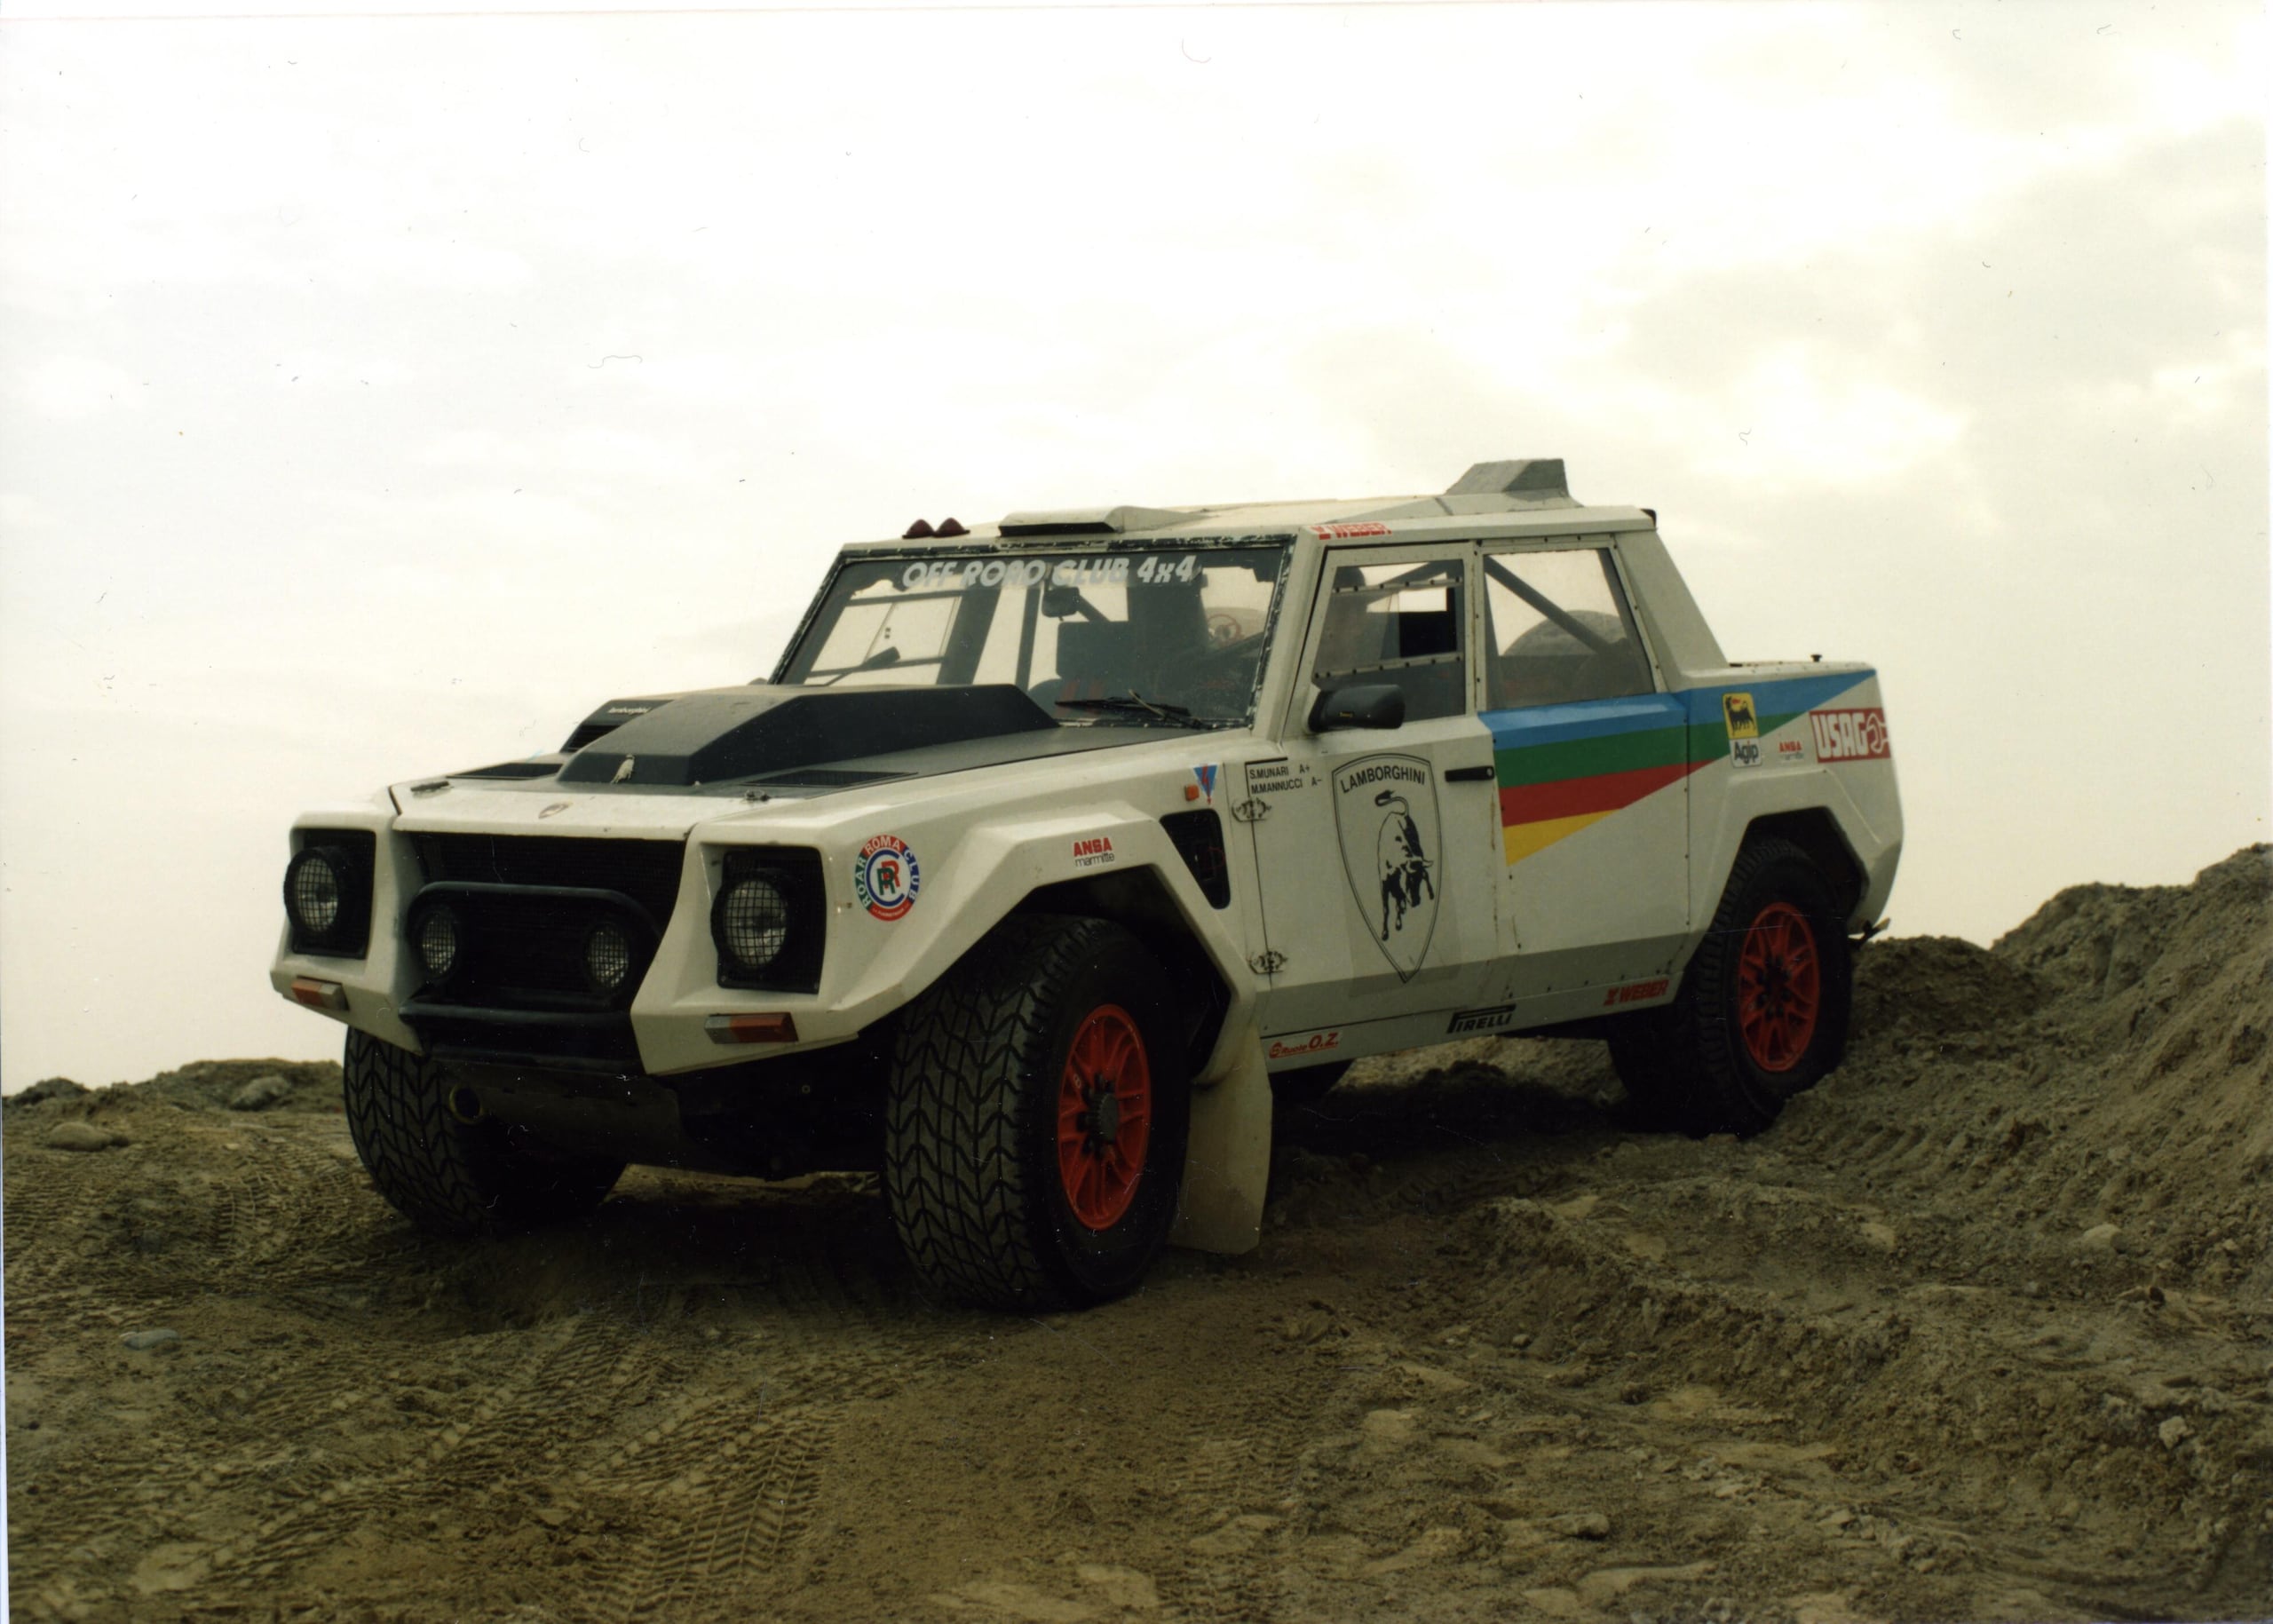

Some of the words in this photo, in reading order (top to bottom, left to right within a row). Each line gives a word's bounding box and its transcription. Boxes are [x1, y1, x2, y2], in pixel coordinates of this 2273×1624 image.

[902, 561, 957, 588] OFF
[960, 559, 1046, 587] ROAD
[1052, 558, 1129, 586] CLUB
[1136, 555, 1197, 583] 4x4
[1811, 712, 1868, 759] USAG
[1734, 741, 1759, 764] Agip
[1249, 766, 1289, 780] S.MUNARI
[1341, 765, 1425, 794] LAMBORGHINI
[1251, 778, 1303, 795] M.MANNUCCI
[1073, 837, 1113, 857] ANSA
[865, 836, 901, 855] ROMA
[904, 849, 920, 900] CLUB
[1620, 978, 1669, 1002] WEBER
[1446, 1003, 1517, 1034] PIRELLI
